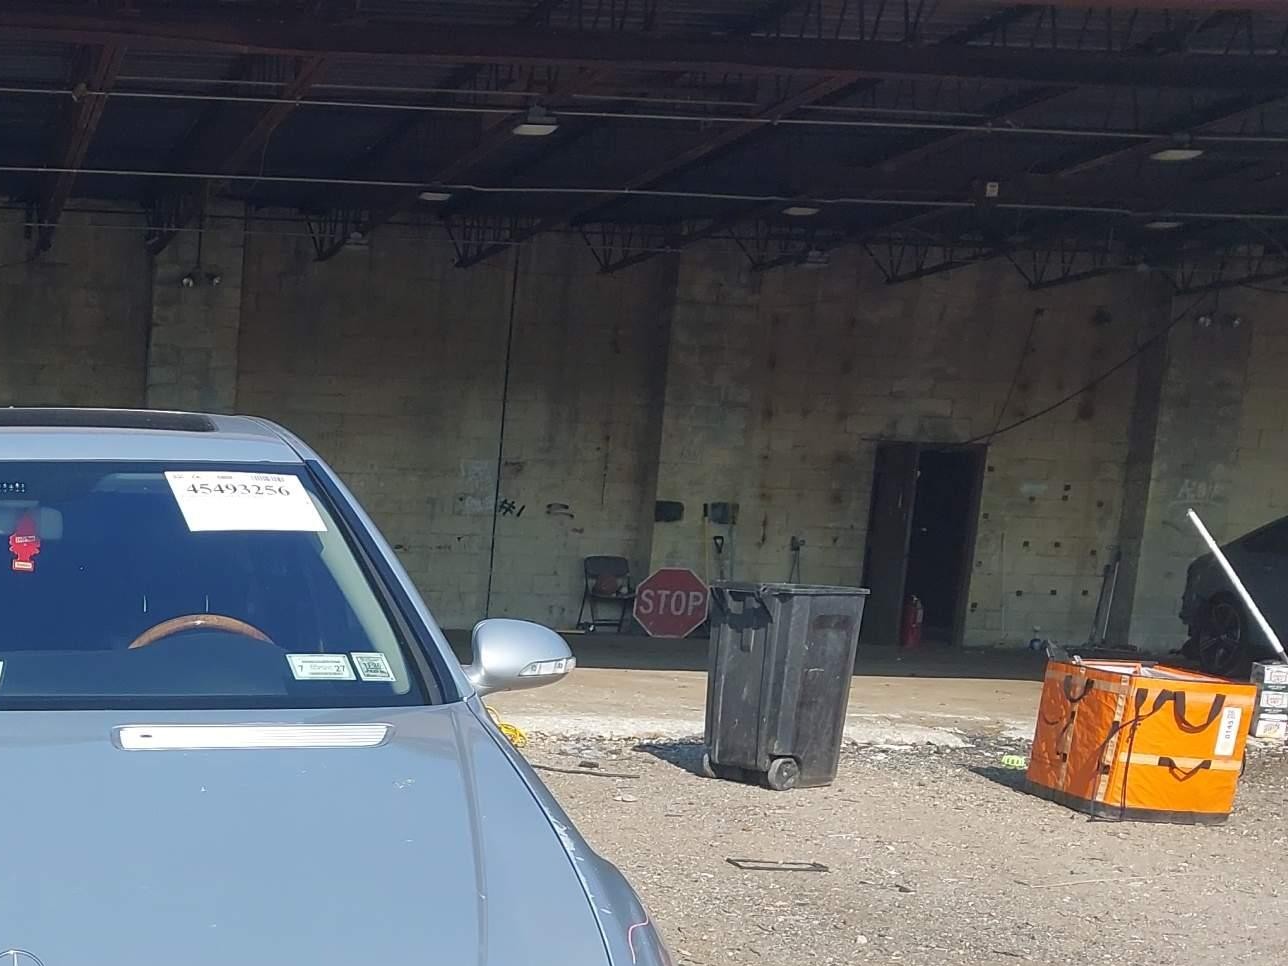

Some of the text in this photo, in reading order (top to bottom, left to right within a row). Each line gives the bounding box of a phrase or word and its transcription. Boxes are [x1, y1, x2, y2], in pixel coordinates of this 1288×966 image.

[186, 482, 290, 497] 45493256
[639, 588, 704, 616] STOP
[334, 664, 346, 673] 27
